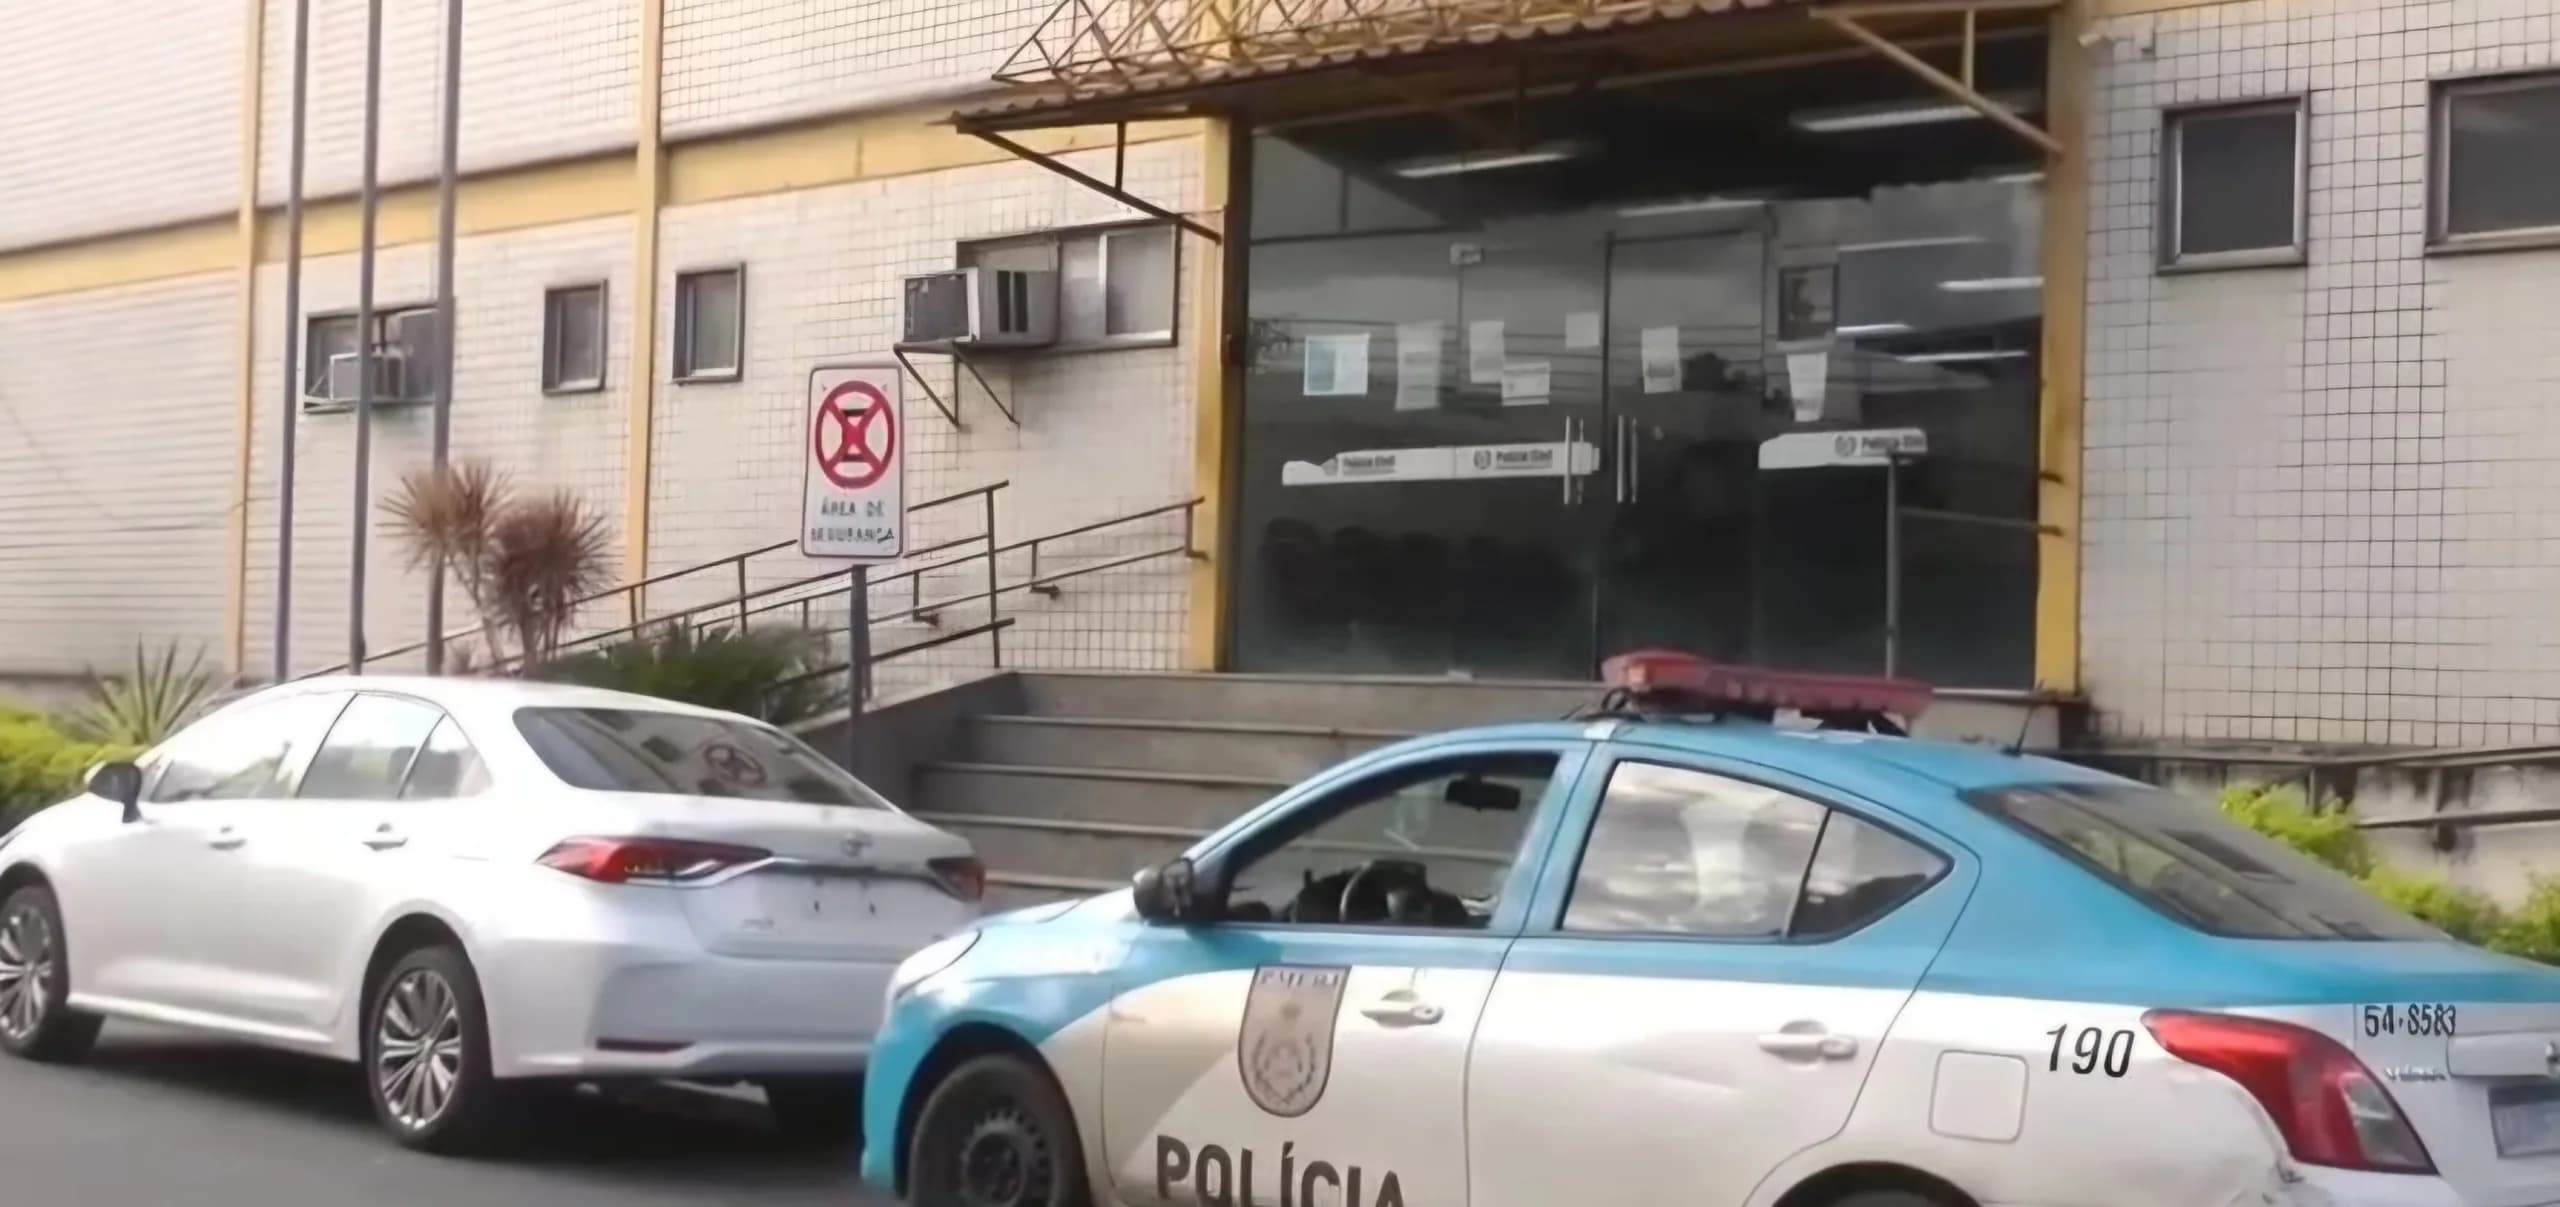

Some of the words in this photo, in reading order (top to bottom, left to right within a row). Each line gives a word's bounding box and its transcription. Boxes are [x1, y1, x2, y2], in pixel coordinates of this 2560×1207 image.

[820, 496, 856, 517] ÁREA
[866, 499, 885, 518] DE
[2045, 1023, 2135, 1079] 190
[1156, 1133, 1405, 1207] POLÍCIA
